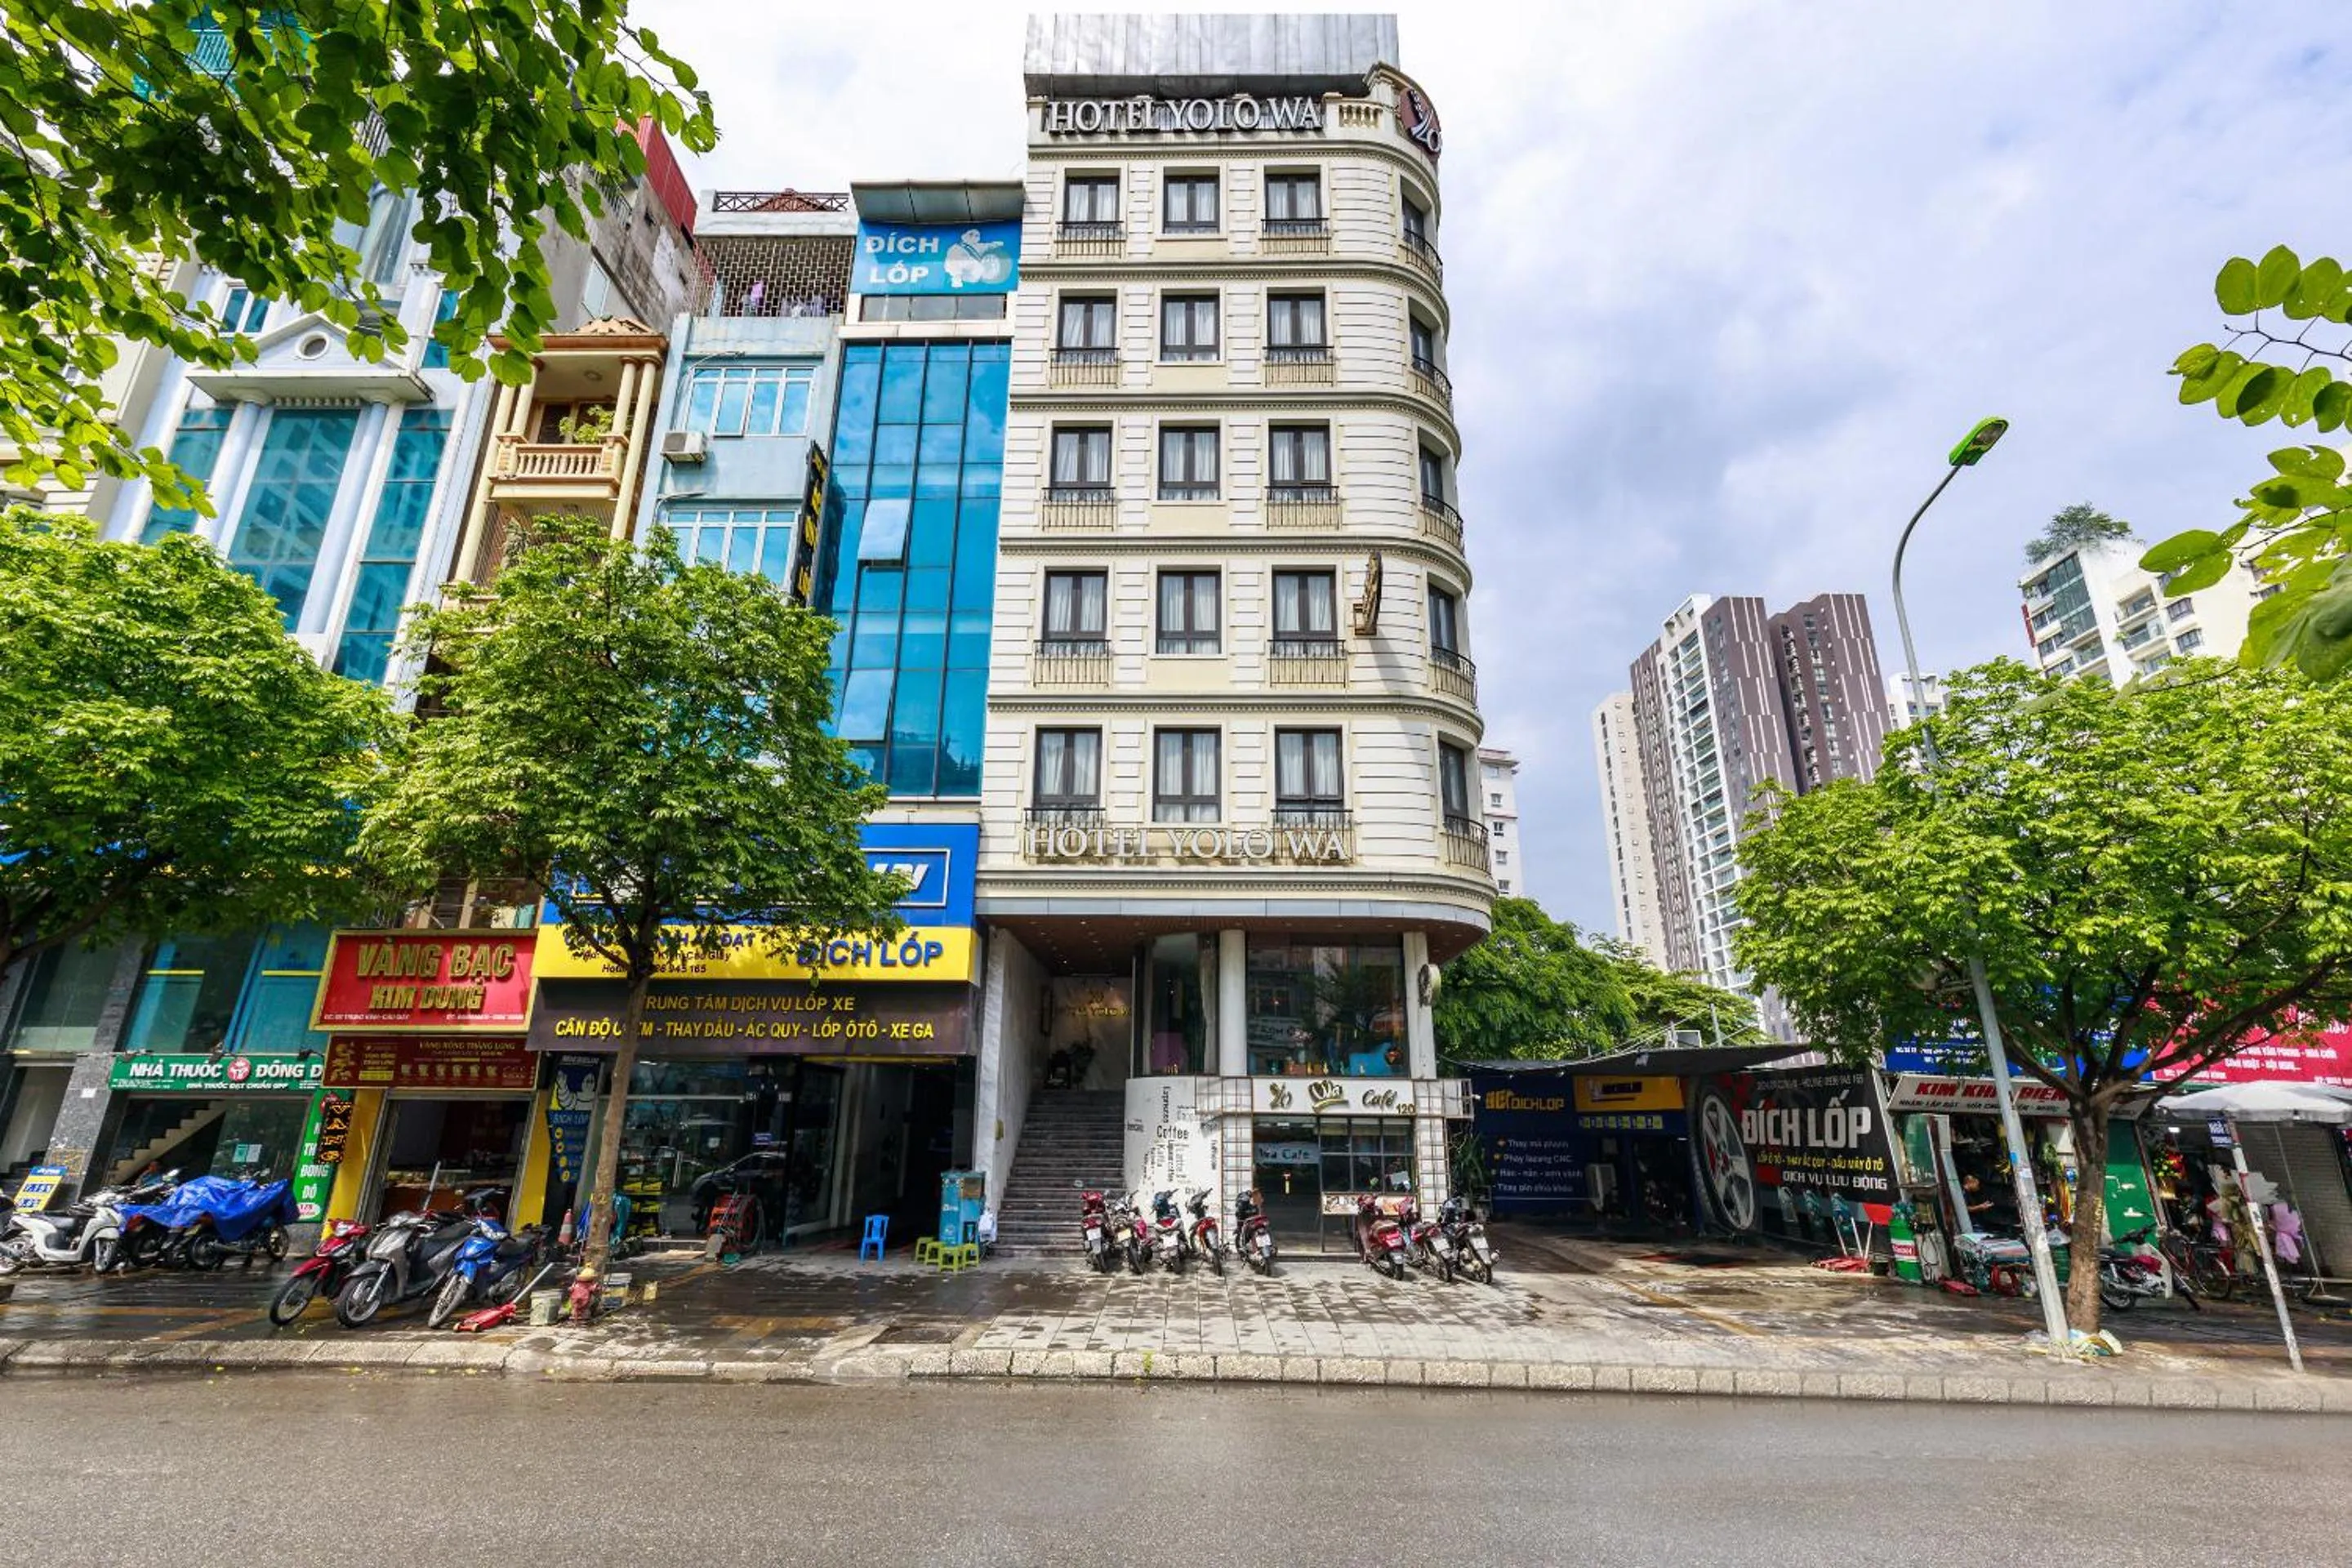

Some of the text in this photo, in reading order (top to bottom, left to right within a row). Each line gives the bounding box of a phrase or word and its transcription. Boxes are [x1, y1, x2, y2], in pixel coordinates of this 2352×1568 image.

[1049, 96, 1324, 132] HOTEL YOLO WA
[865, 232, 939, 254] ĐÍCH
[869, 260, 929, 284] LỐP
[1027, 827, 1351, 861] HOTEL YOLO WA
[356, 937, 516, 983] VÀNG BẠC
[879, 930, 943, 967] LỐP
[369, 985, 487, 1009] KIM DUNG
[694, 992, 727, 1010] TÂM
[730, 996, 770, 1013] DỊCH
[770, 996, 792, 1015] VỤ
[795, 991, 827, 1011] LỐP
[831, 996, 855, 1011] XE
[588, 1017, 611, 1041] ĐỘ
[665, 1021, 701, 1038] THAY
[704, 1015, 735, 1038] DẦU
[744, 1018, 767, 1038] ÁC
[770, 1021, 800, 1039] QUY
[812, 1016, 841, 1038] LỐP
[845, 1019, 877, 1038] ÔTÔ
[889, 1022, 910, 1038] XE
[912, 1022, 934, 1039] GA
[129, 1059, 164, 1077] NHÀ
[168, 1059, 222, 1078] THUỐC
[255, 1061, 305, 1078] ĐÔNG
[1914, 1082, 1958, 1097] KIM
[1396, 1102, 1416, 1115] 120
[1740, 1089, 1872, 1149] ĐÍCH LỐP
[1156, 1125, 1190, 1140] Coffee
[1782, 1170, 1806, 1184] DỊCH
[1852, 1174, 1888, 1192] ĐỘNG
